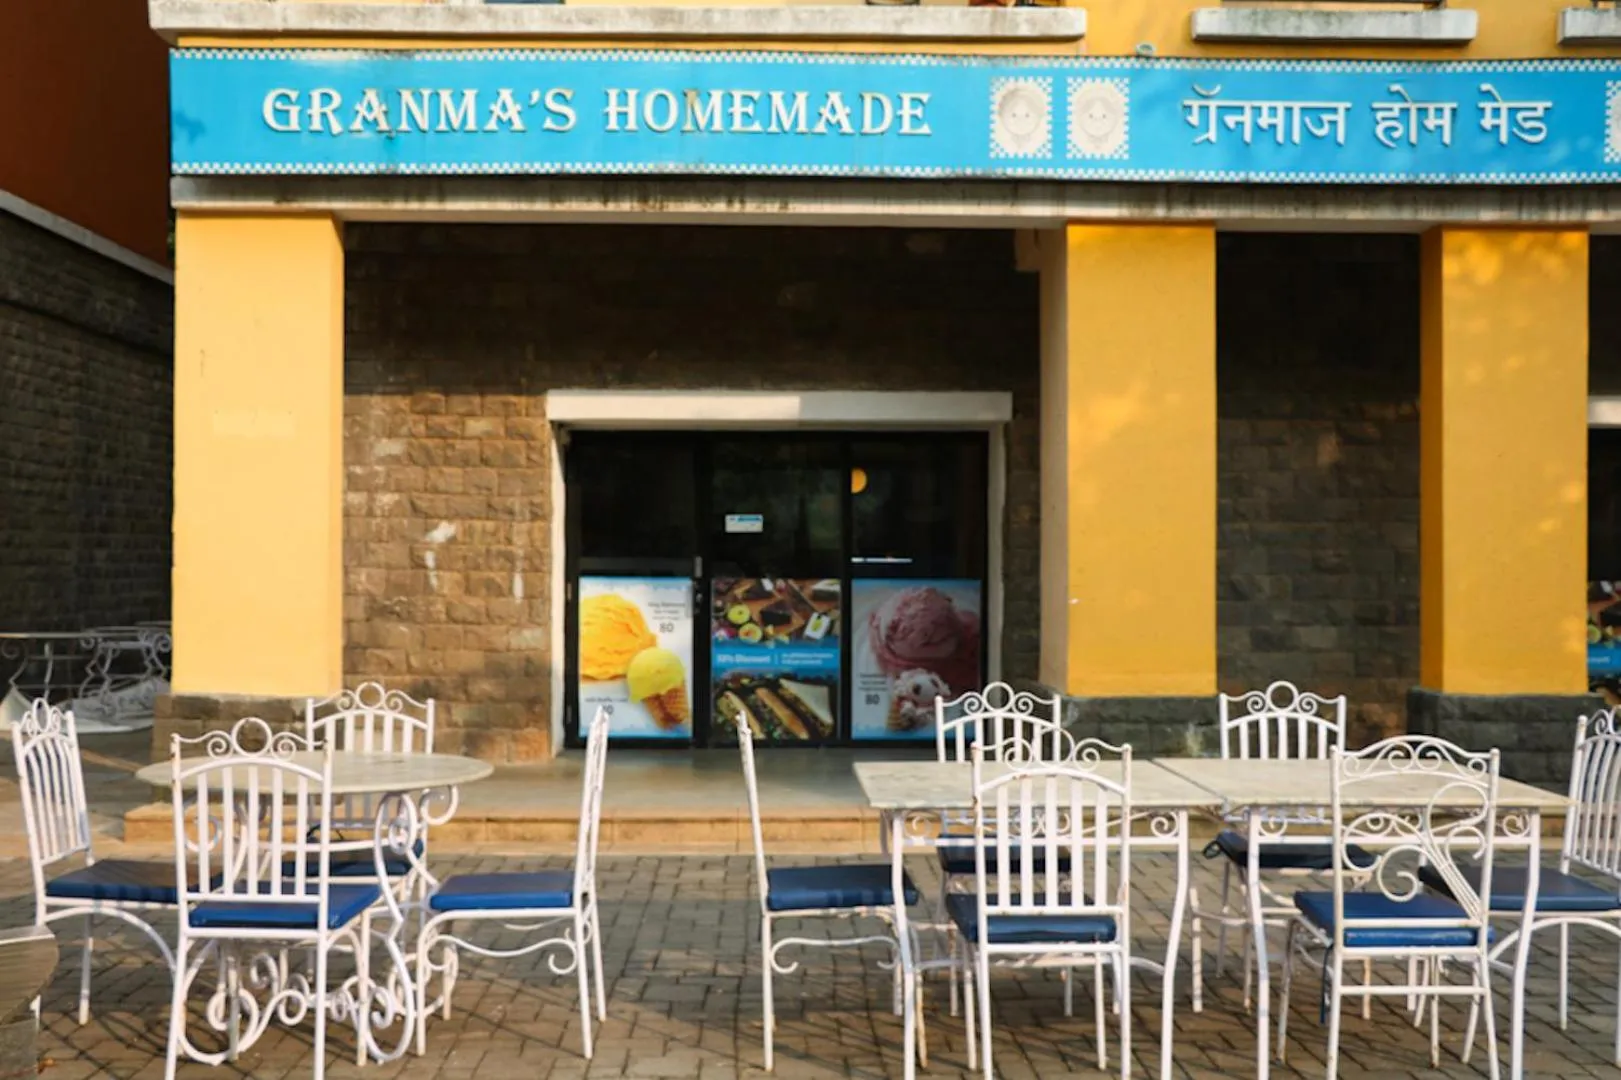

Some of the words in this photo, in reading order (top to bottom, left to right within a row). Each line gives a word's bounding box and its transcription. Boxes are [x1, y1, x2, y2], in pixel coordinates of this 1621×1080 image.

[262, 87, 578, 135] GRANMA'S
[604, 89, 933, 137] HOMEMADE
[1371, 83, 1459, 149] होम
[1477, 83, 1553, 145] मेड
